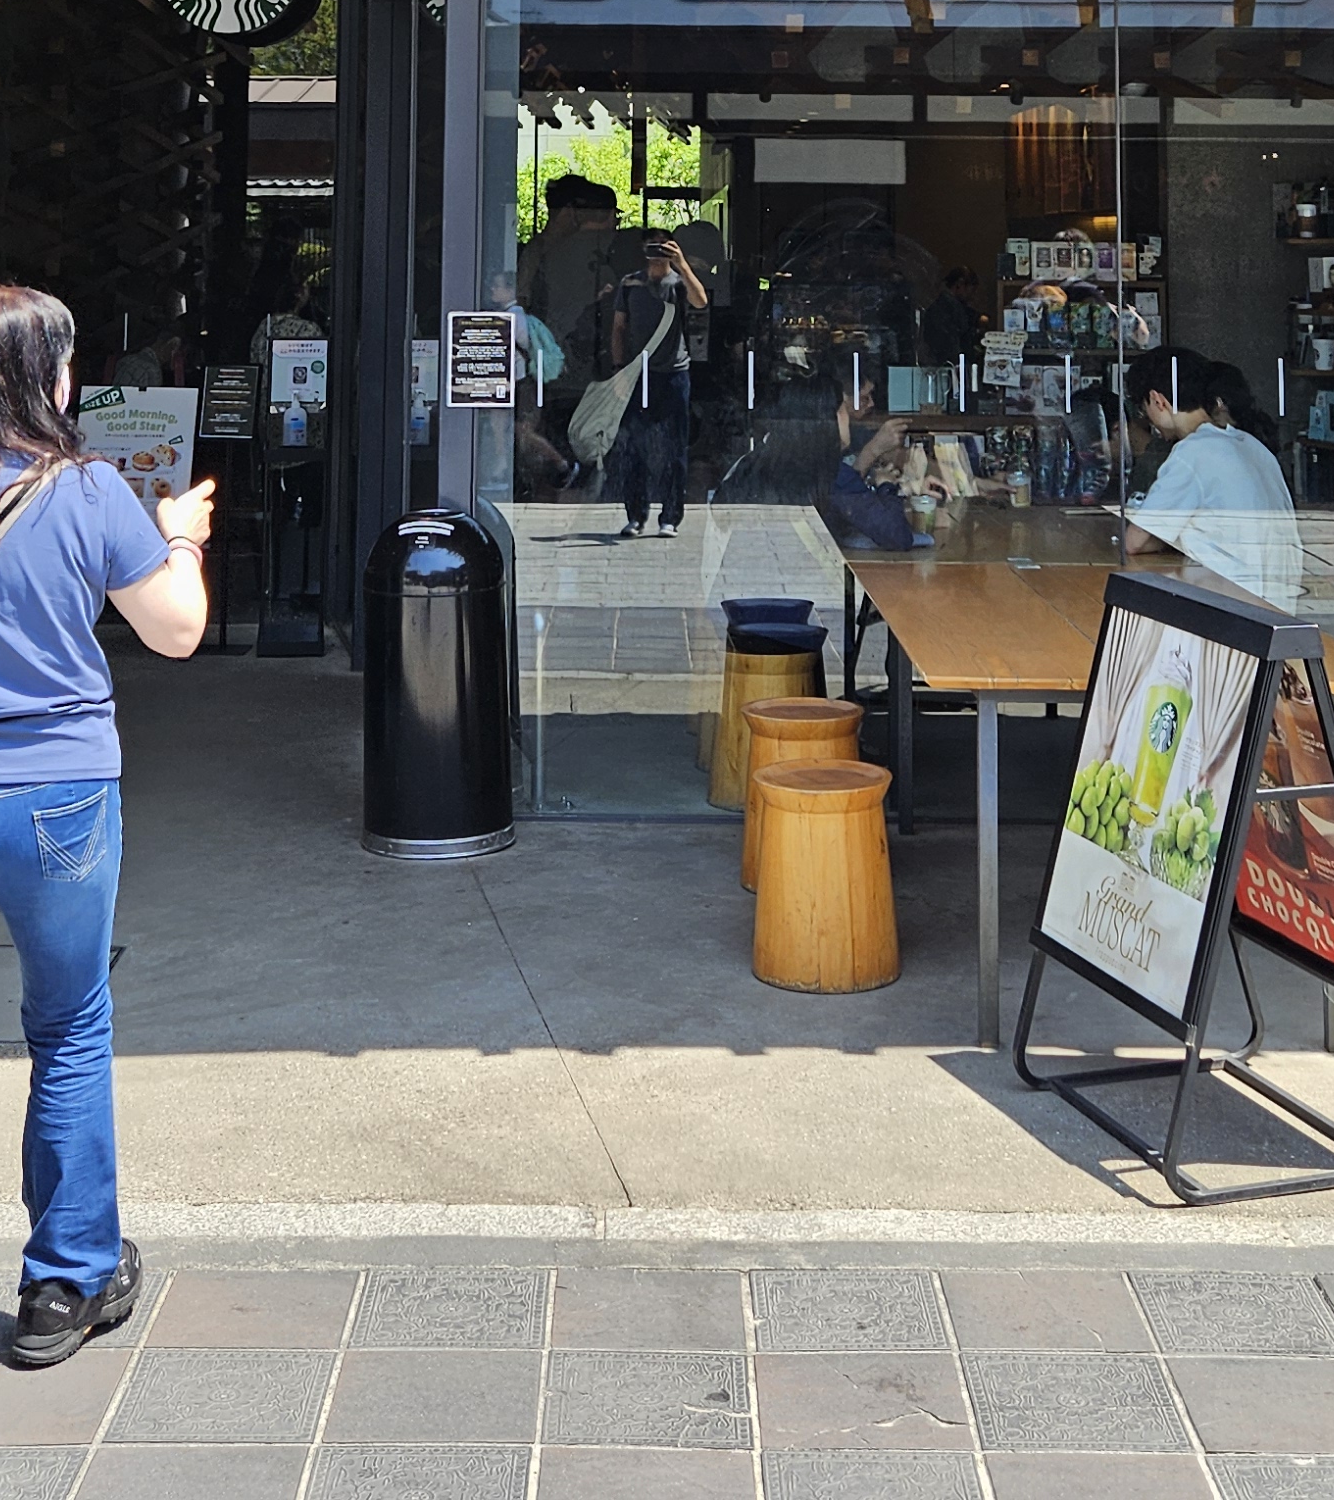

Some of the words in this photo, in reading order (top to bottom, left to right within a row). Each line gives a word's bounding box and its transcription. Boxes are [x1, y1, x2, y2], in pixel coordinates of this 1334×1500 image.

[101, 390, 120, 404] UP
[95, 409, 126, 422] Good
[128, 408, 178, 424] Morning,
[106, 420, 137, 432] Good
[139, 420, 167, 432] Start
[1096, 875, 1153, 923] Grand
[1078, 891, 1160, 973] MUSCAT
[49, 1301, 71, 1313] AIGLE
